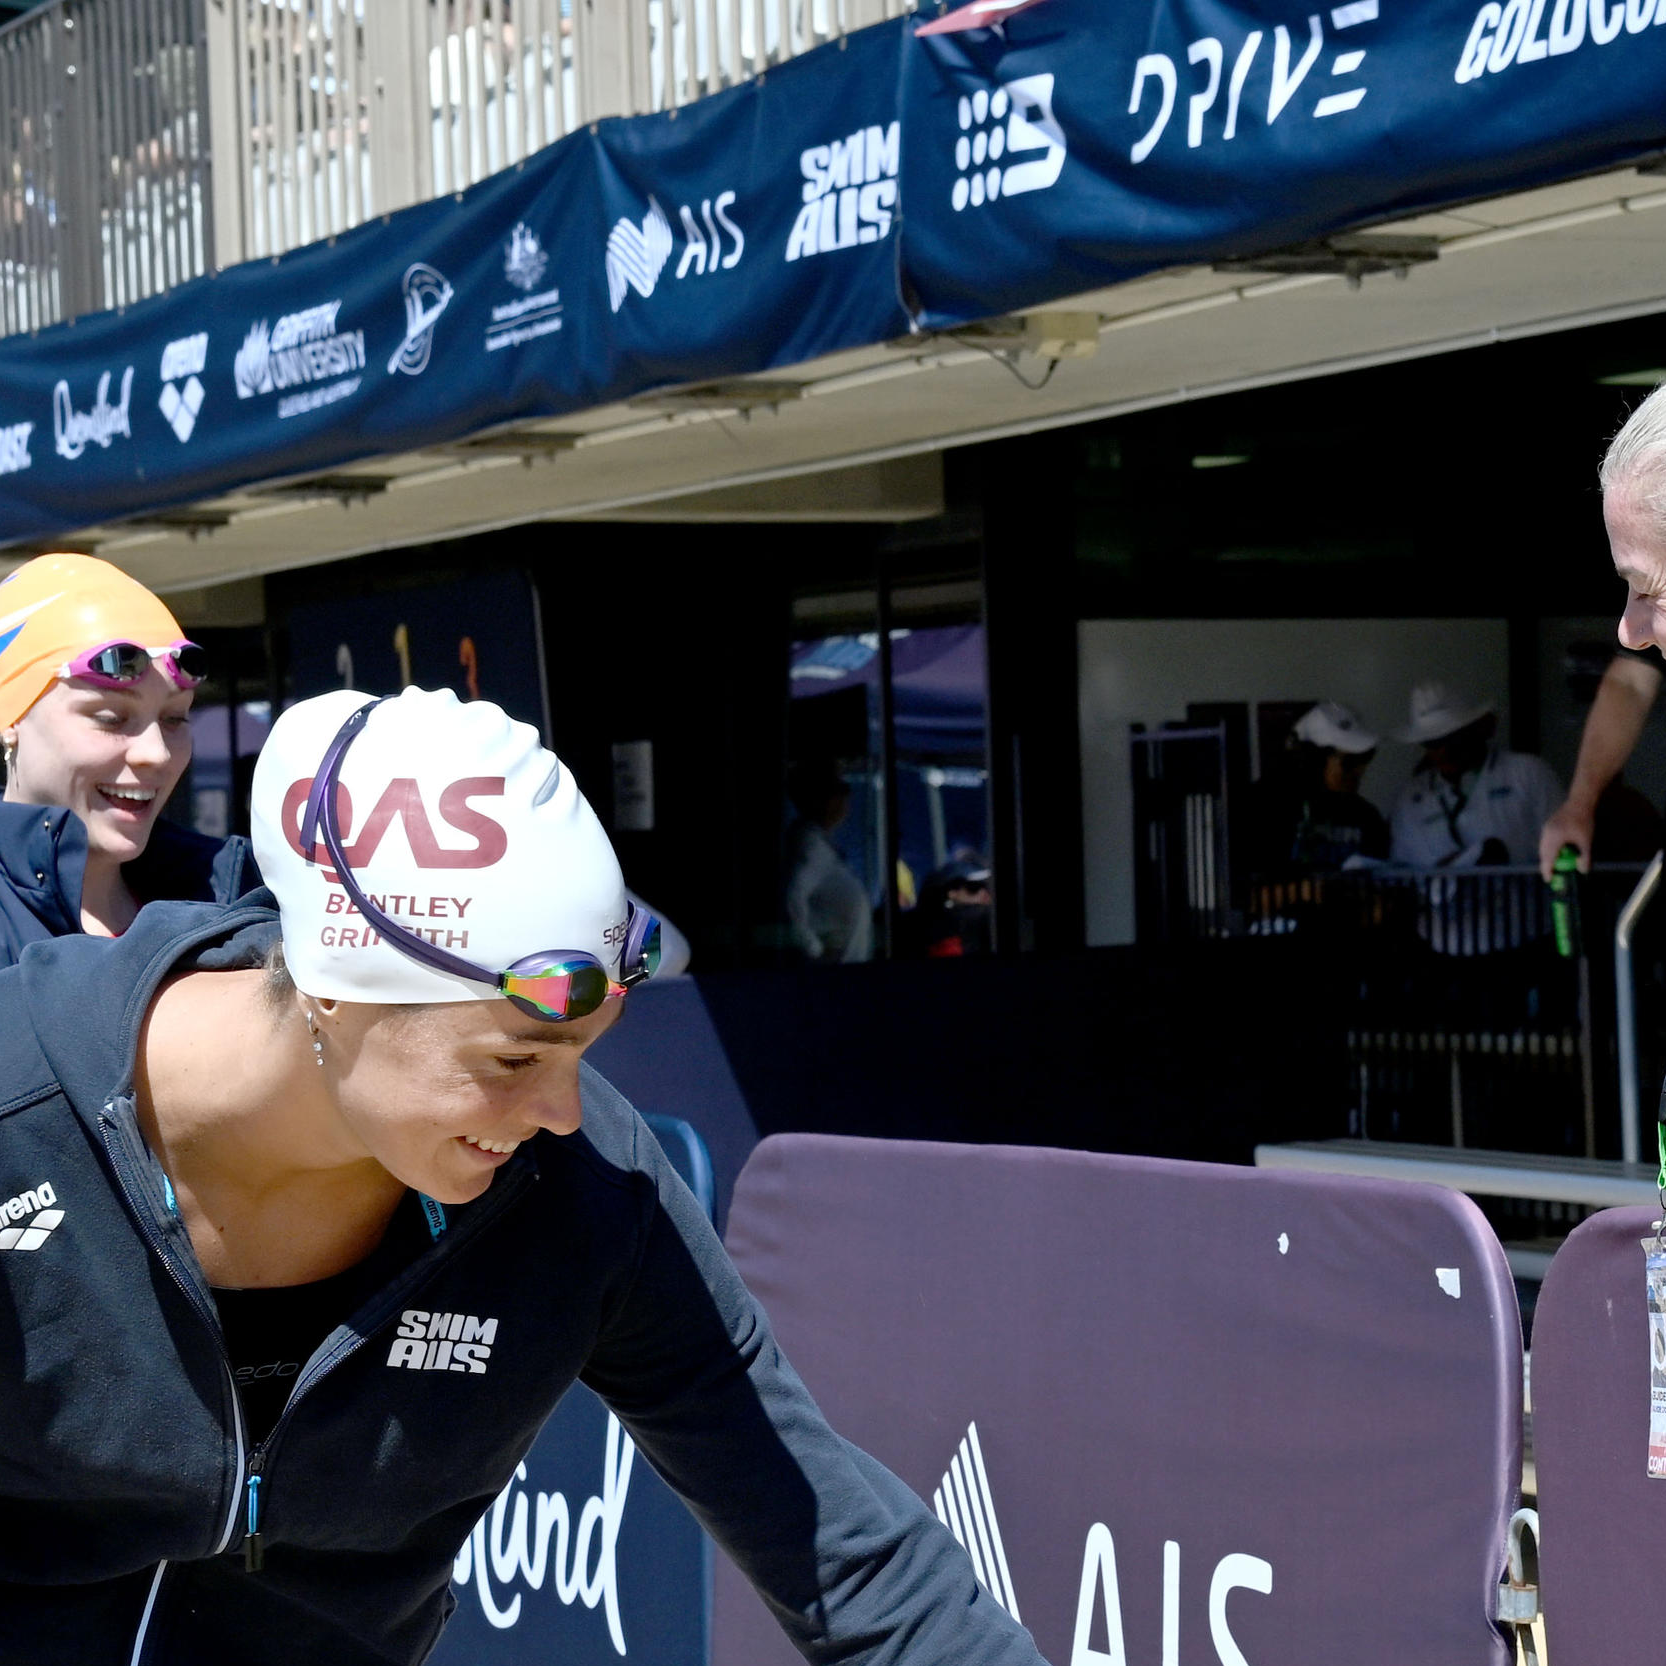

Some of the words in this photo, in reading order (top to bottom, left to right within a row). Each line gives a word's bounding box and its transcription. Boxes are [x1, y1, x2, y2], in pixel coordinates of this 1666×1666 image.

[1128, 0, 1379, 164] DRIVE
[800, 121, 901, 203] SWIM
[675, 190, 744, 280] AIS
[785, 179, 898, 262] AUS
[269, 328, 366, 390] UNIVERSITY
[320, 925, 469, 949] GRIITH
[426, 1200, 442, 1229] arena
[386, 1338, 491, 1374] AUS
[397, 1309, 499, 1345] SWIM
